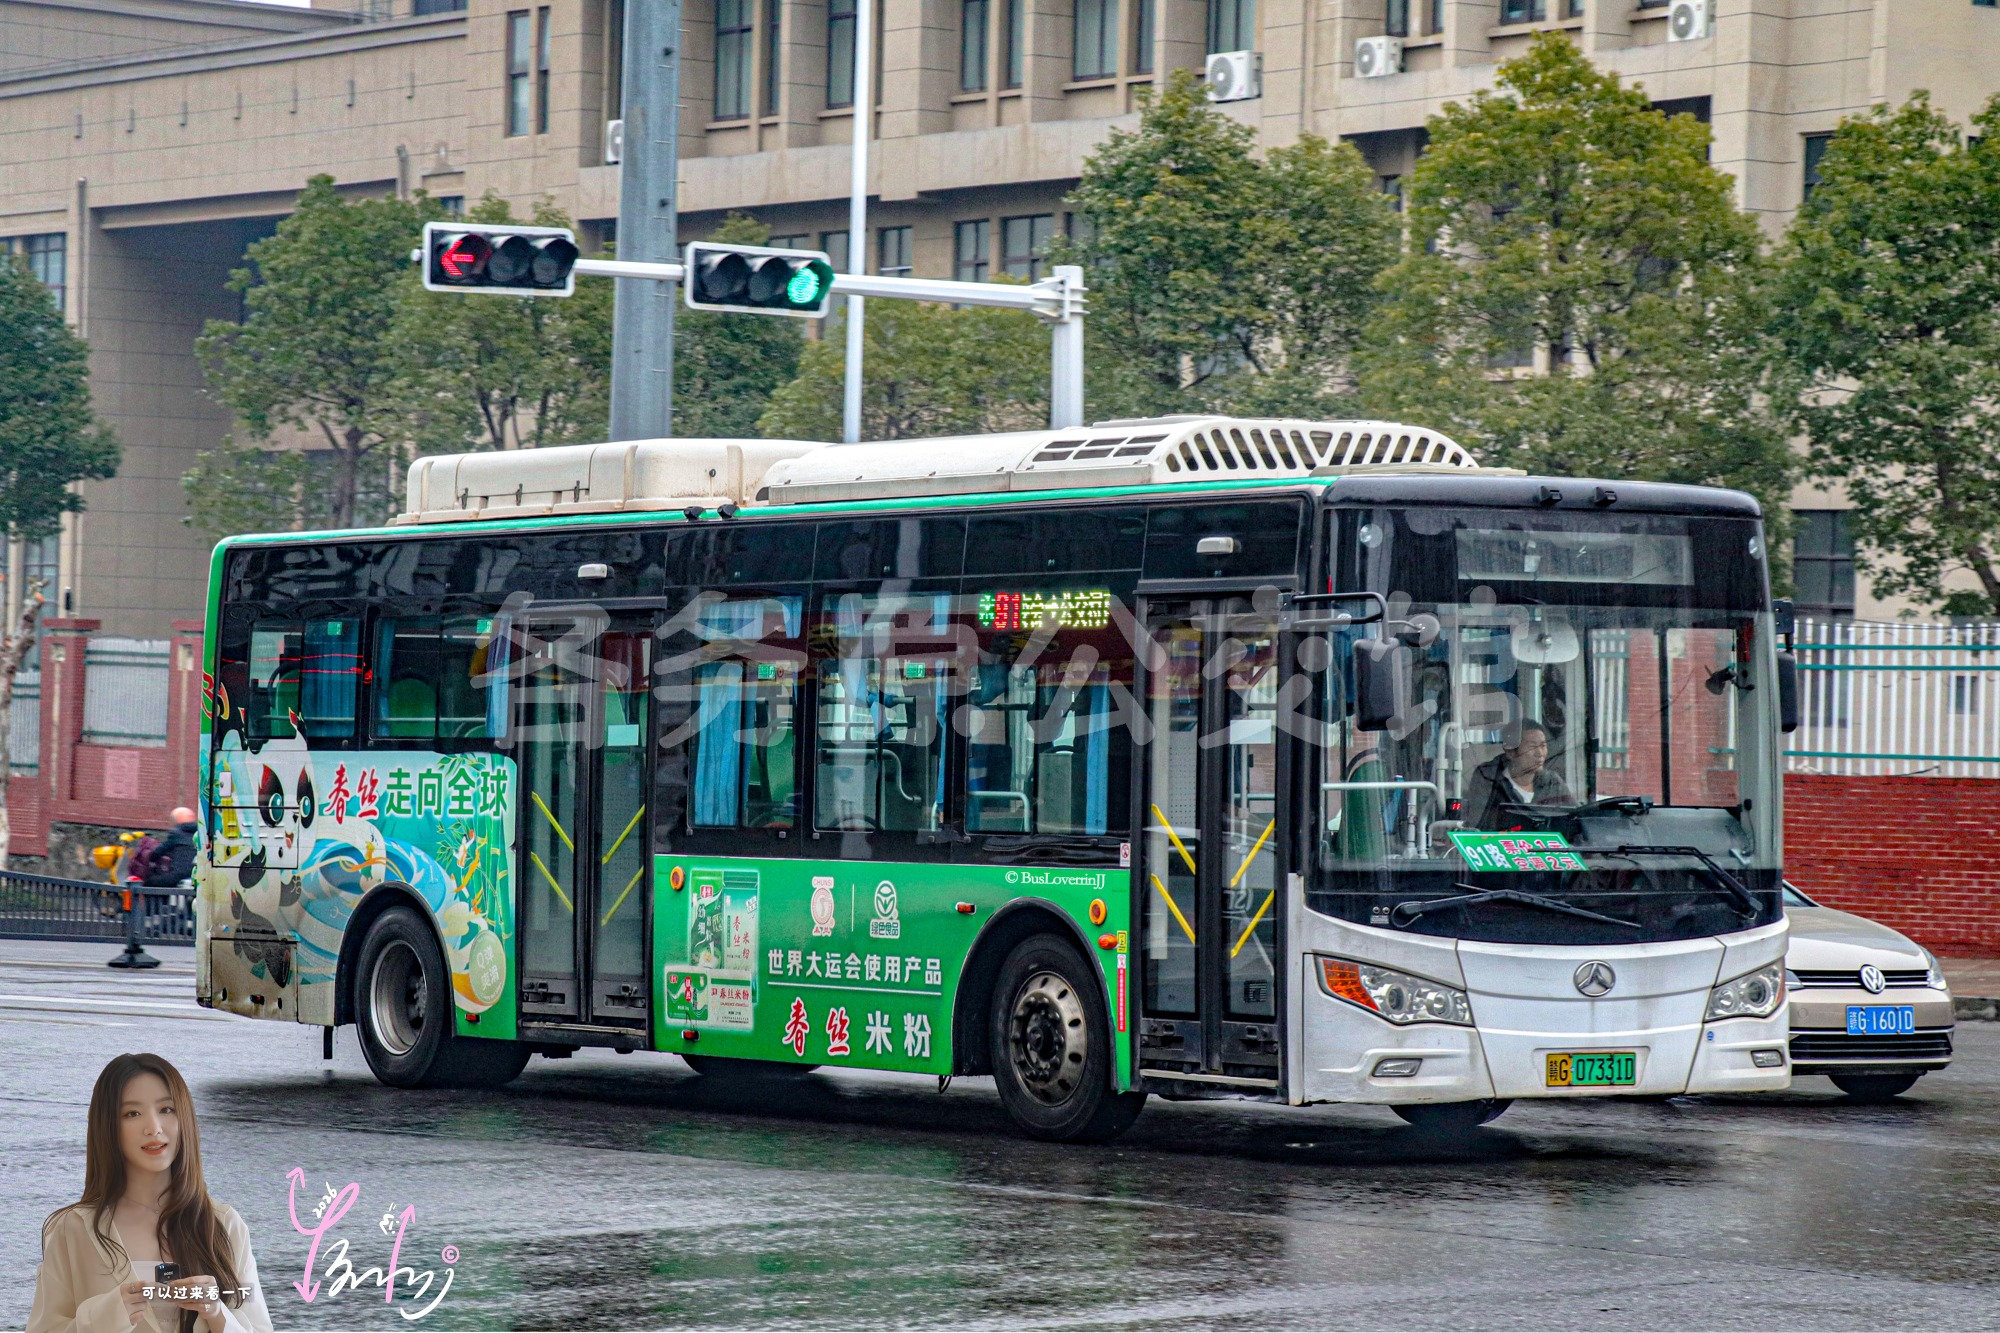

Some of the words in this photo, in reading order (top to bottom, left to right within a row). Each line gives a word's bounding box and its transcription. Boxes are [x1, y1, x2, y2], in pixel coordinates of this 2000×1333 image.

[1512, 857, 1581, 871] 空调2元
[768, 948, 942, 985] 世界大运会使用产品
[783, 997, 932, 1056] 春丝米粉
